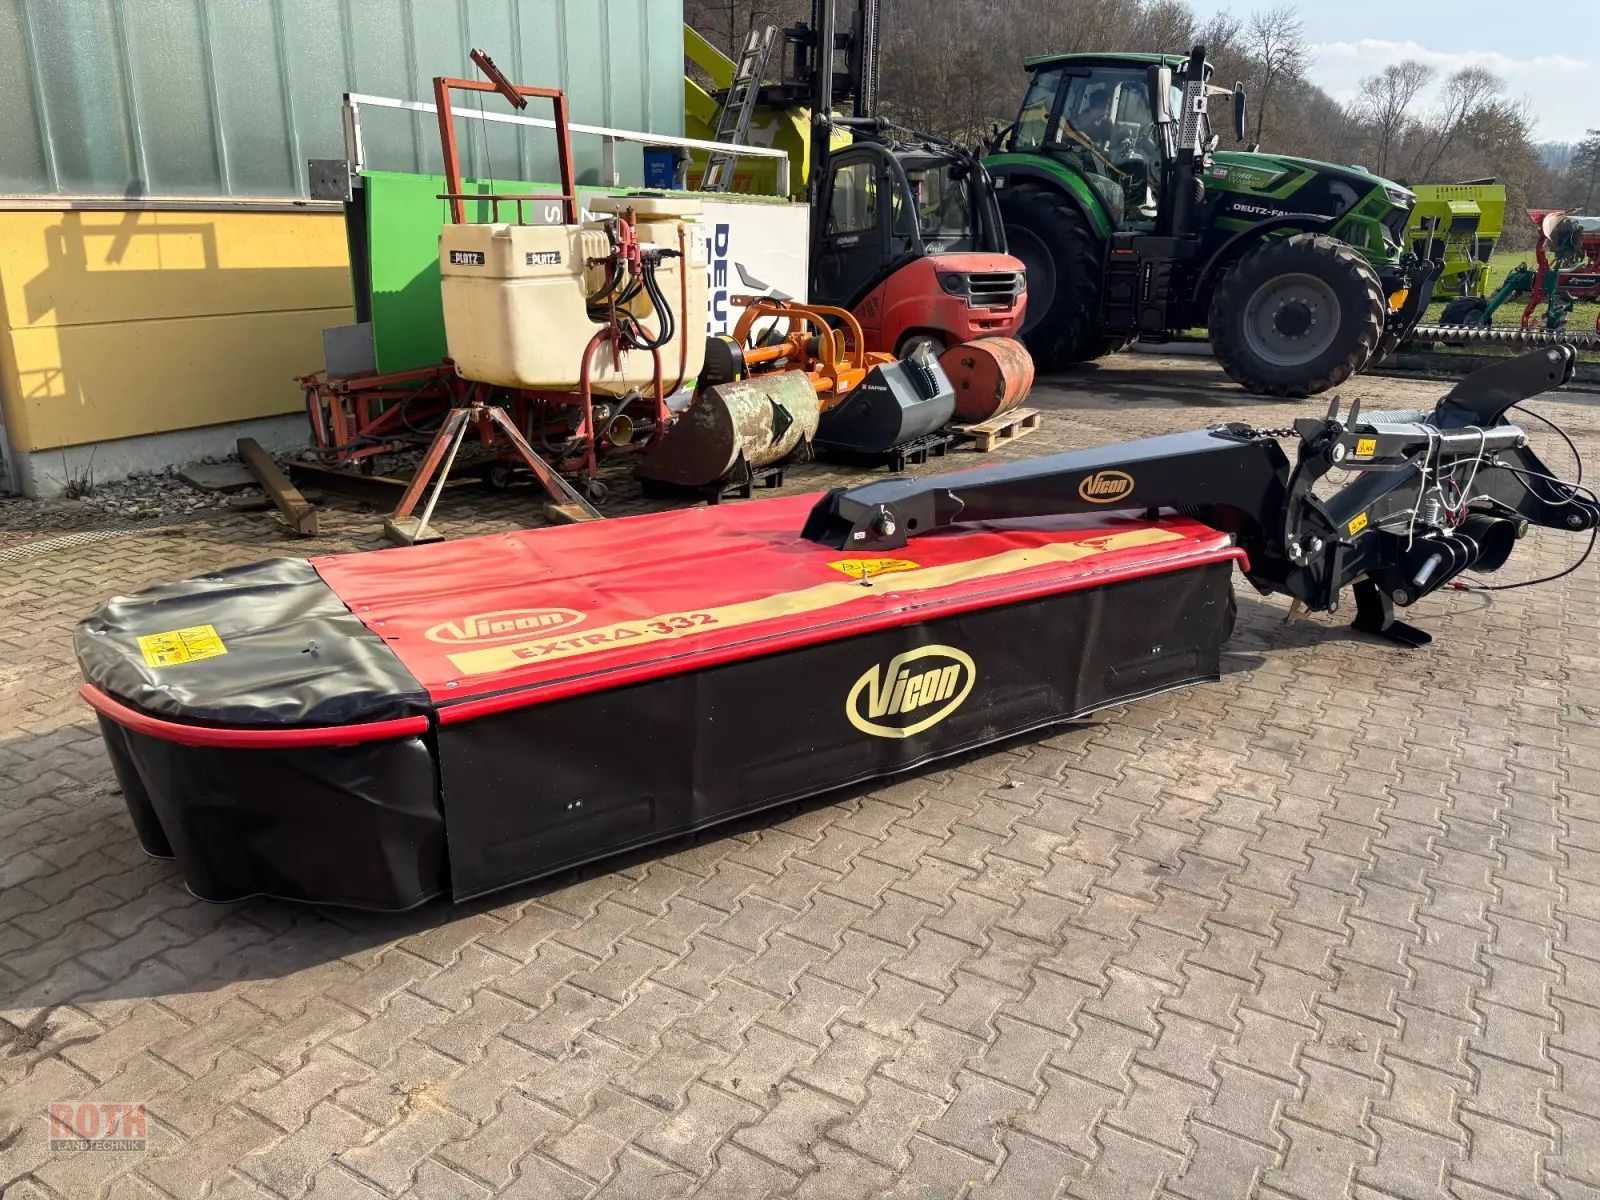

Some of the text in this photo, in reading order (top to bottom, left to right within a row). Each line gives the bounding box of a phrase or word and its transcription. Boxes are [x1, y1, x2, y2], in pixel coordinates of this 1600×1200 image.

[1232, 203, 1296, 217] DEUTZ-FA
[455, 252, 478, 265] PLATZ
[531, 253, 556, 265] PLATZ
[1084, 473, 1130, 497] Vicon
[439, 610, 573, 641] Vicon
[511, 613, 720, 660] EXTRA 332
[862, 652, 963, 721] Vicon
